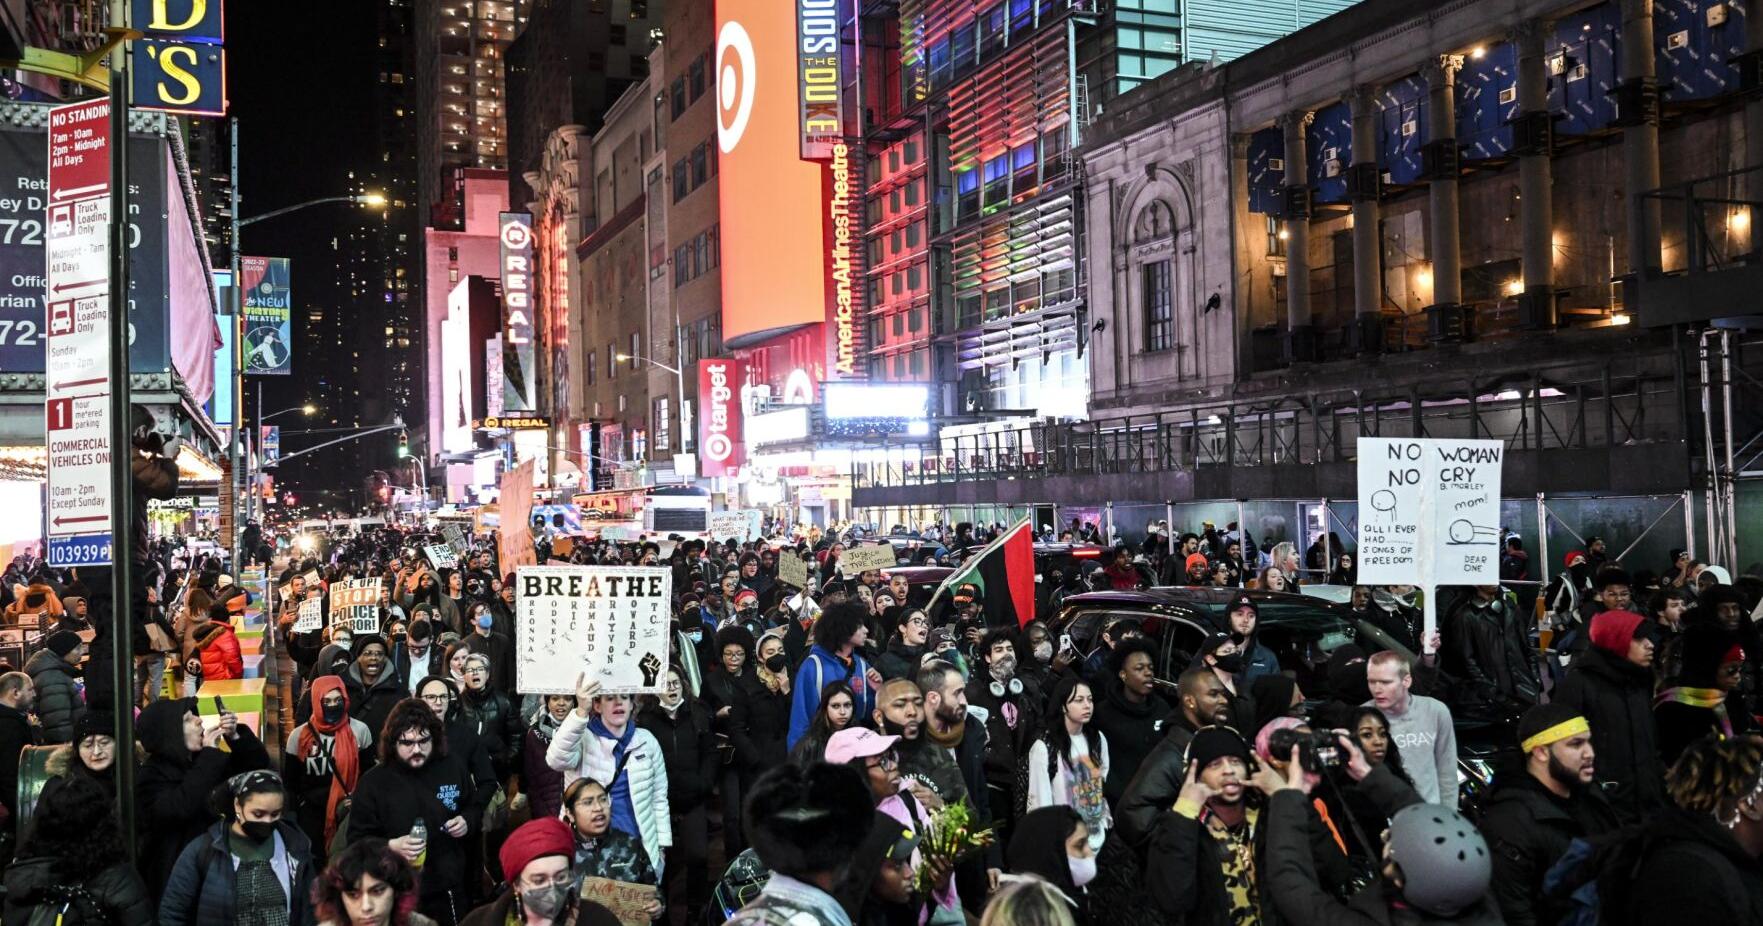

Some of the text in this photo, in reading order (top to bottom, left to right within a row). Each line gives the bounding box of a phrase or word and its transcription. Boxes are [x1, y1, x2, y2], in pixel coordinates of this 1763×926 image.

[804, 57, 836, 66] THE
[52, 113, 66, 127] NO
[53, 133, 68, 144] 7am
[73, 128, 93, 140] 10am
[53, 145, 68, 157] 2pm
[74, 136, 105, 152] Midnight
[53, 154, 83, 168] All Days
[77, 202, 98, 213] Truck
[77, 212, 107, 225] Loading
[77, 225, 95, 236] Only
[51, 262, 80, 273] All Days
[77, 299, 98, 311] Truck
[257, 297, 284, 308] NEW
[506, 255, 529, 344] REGAL
[77, 310, 107, 322] Loading
[77, 322, 94, 333] Only
[51, 345, 78, 358] Sunday
[707, 364, 732, 433] target
[56, 401, 64, 428] 1
[75, 408, 103, 419] metered
[75, 420, 100, 430] parking
[501, 419, 548, 427] REGAL
[51, 437, 109, 453] COMMERCIAL
[1388, 443, 1500, 464] NO WOMAN
[51, 453, 93, 468] VEHICLES
[1388, 466, 1476, 487] NO CRY
[52, 486, 72, 497] 10am
[78, 484, 95, 496] 2pm
[51, 496, 106, 510] Except Sunday
[1395, 524, 1417, 534] EVER
[51, 544, 98, 563] 103939
[1363, 546, 1413, 555] SONGS OF
[1464, 555, 1487, 564] DEAR
[1464, 564, 1483, 572] ONE
[360, 577, 377, 588] UP!
[523, 574, 662, 598] BREATHE
[333, 589, 374, 608] STOP
[331, 605, 376, 624] POLICE
[1394, 731, 1436, 749] GRAY
